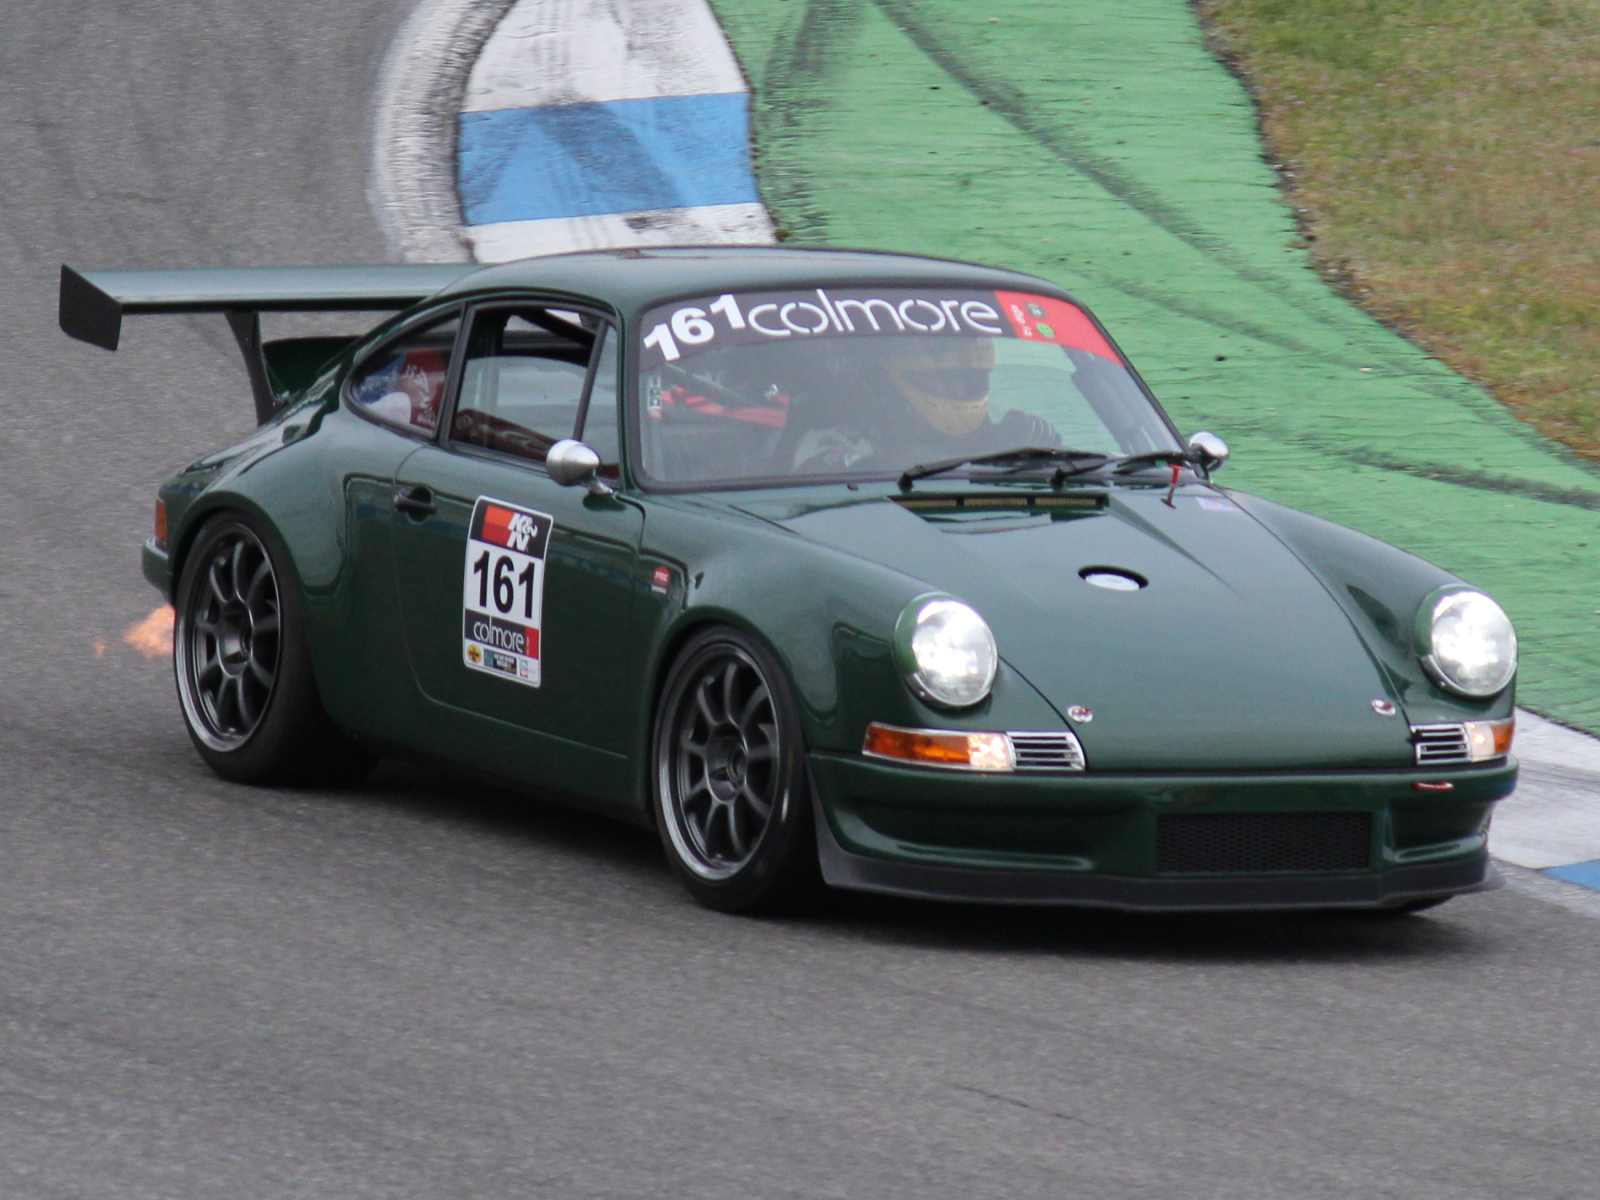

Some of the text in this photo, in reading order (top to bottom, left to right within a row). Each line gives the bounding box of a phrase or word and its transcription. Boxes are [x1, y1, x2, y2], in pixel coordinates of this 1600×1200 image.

[643, 288, 1004, 361] 161 colmore
[507, 512, 538, 552] K&N
[473, 550, 536, 619] 161
[473, 616, 525, 654] colmore
